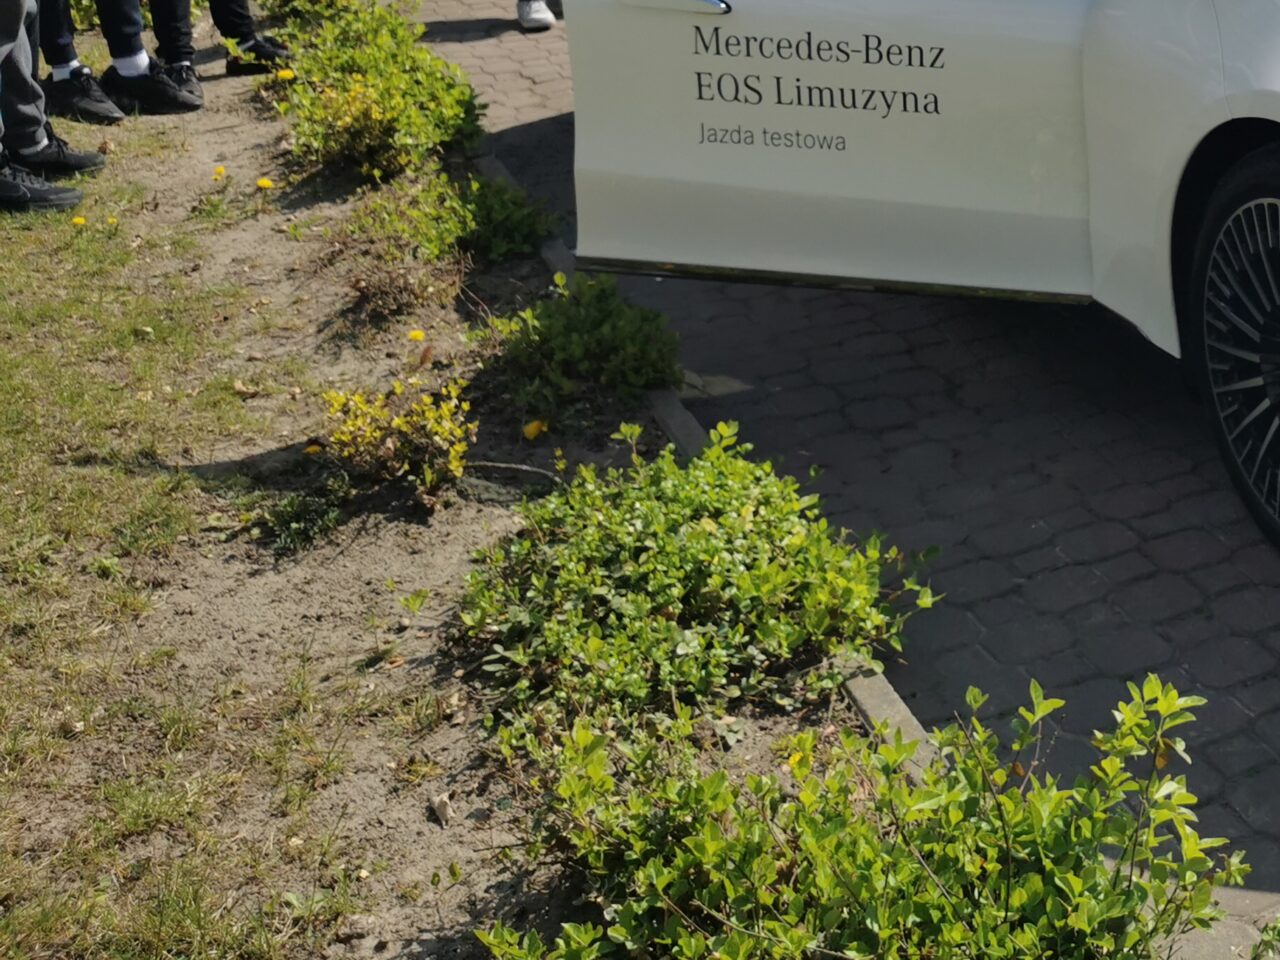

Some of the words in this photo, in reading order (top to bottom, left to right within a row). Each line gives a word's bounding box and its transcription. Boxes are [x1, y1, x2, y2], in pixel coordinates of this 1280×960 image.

[693, 25, 946, 69] Mercedes-Benz
[694, 71, 764, 106] EQS
[773, 76, 941, 119] Limuzyna
[699, 123, 755, 145] Jazda
[762, 128, 847, 152] testowa
